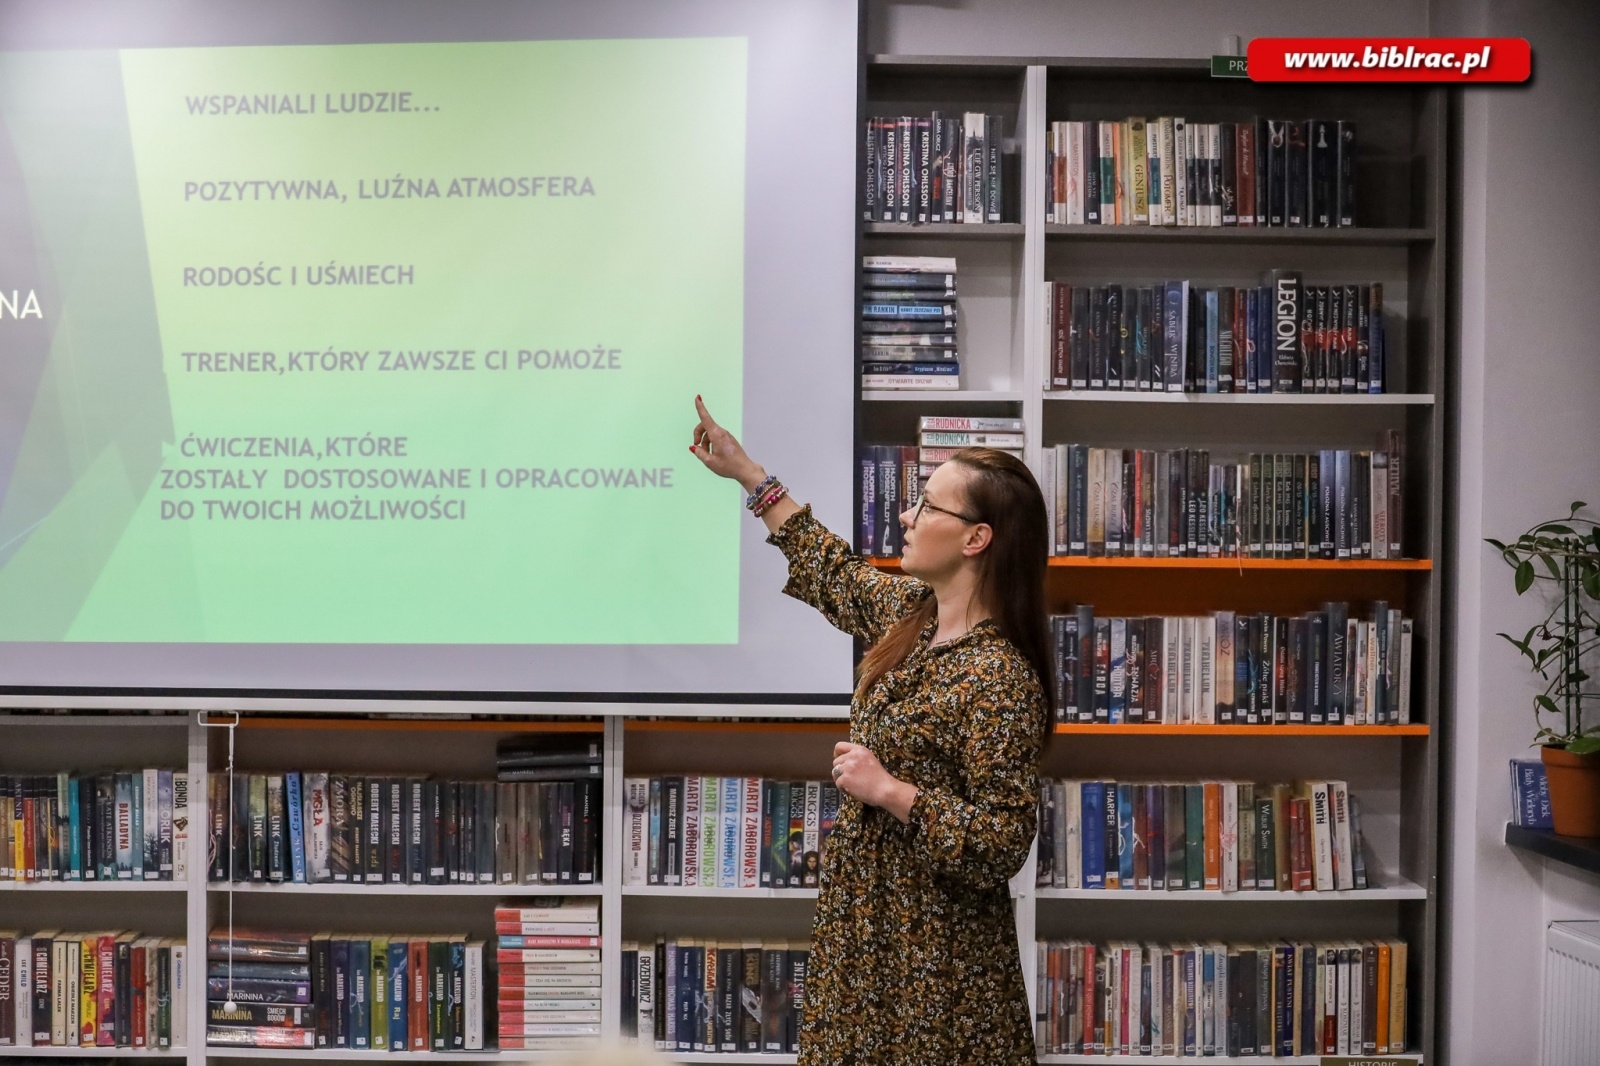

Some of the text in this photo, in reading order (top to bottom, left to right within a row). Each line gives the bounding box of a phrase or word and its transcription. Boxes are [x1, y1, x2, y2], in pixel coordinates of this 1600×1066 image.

[185, 92, 441, 115] WSPANIALI LUDZIE...
[867, 130, 875, 206] KRISTINA OHLSSON
[886, 131, 895, 207] KRISTINA OHLSSON
[902, 131, 910, 207] KRISTINA OHLSSON
[920, 131, 929, 207] KRISTINA OHLSSON
[974, 148, 982, 211] LEIF GW PERSSON
[184, 173, 596, 204] POZYTYWNA, LUŹNA ATMOSFERA
[1135, 164, 1144, 211] GENIUSZ
[291, 266, 297, 286] I
[306, 260, 415, 286] UŚMIECH
[873, 305, 895, 313] RANKIN
[1168, 310, 1177, 339] SABLIK
[1277, 278, 1297, 351] LEGION
[378, 350, 476, 371] ZAWSZE
[485, 350, 508, 370] CI
[517, 344, 622, 370] POMOŻE
[935, 418, 971, 430] RUDNICKA
[935, 433, 971, 446] RUDNICKA
[160, 468, 674, 489] ZOSTAŁY DOSTOSOWANE I OPRACOWANE
[1391, 458, 1400, 496] MAILER
[160, 494, 466, 520] DO TWOICH MOŻLIWOŚCI
[1131, 666, 1140, 703] INWAZJA
[1260, 660, 1271, 703] Żółte ptaki
[175, 781, 187, 809] BONDA
[313, 788, 323, 826] MGŁA
[335, 781, 345, 826] ZMORA
[371, 783, 379, 812] ROBERT
[704, 777, 717, 812] MARTA
[725, 777, 738, 813] MARTA
[746, 777, 759, 813] MARTA
[807, 786, 818, 827] BRIGGS
[1107, 791, 1115, 826] HARPER
[1315, 792, 1327, 825] SMITH
[1336, 790, 1345, 824] SMITH
[1541, 800, 1550, 818] Dick
[119, 803, 128, 850] BALLADYNA
[253, 815, 262, 837] LINK
[272, 815, 280, 837] LINK
[371, 813, 379, 844] MAŁECKI
[392, 784, 400, 845] ROBERT MAŁECKI
[412, 783, 421, 844] ROBERT MAŁECKI
[668, 788, 677, 839] MARIUSZ ZIELKE
[561, 829, 570, 847] RĘKA
[632, 814, 642, 851] DZIEDZICTWO
[685, 777, 699, 887] MARTA ZABOROWSKA
[0, 958, 10, 1000] CEDER
[36, 952, 48, 993] CHMIELARZ
[84, 953, 95, 995] CHMIELARZ
[101, 951, 113, 993] CHMIELARZ
[639, 956, 651, 1003] GRZĘDOWICZ
[1217, 953, 1226, 978] Znajdź
[226, 992, 264, 1001] MARININA
[376, 976, 384, 1002] MARKLUND
[393, 974, 402, 1020] MARKLUND Raj
[667, 985, 676, 1011] THOMAS
[793, 962, 804, 1009] CHRISTINE
[212, 1009, 252, 1021] MARININA
[667, 1013, 675, 1035] HARRIS
